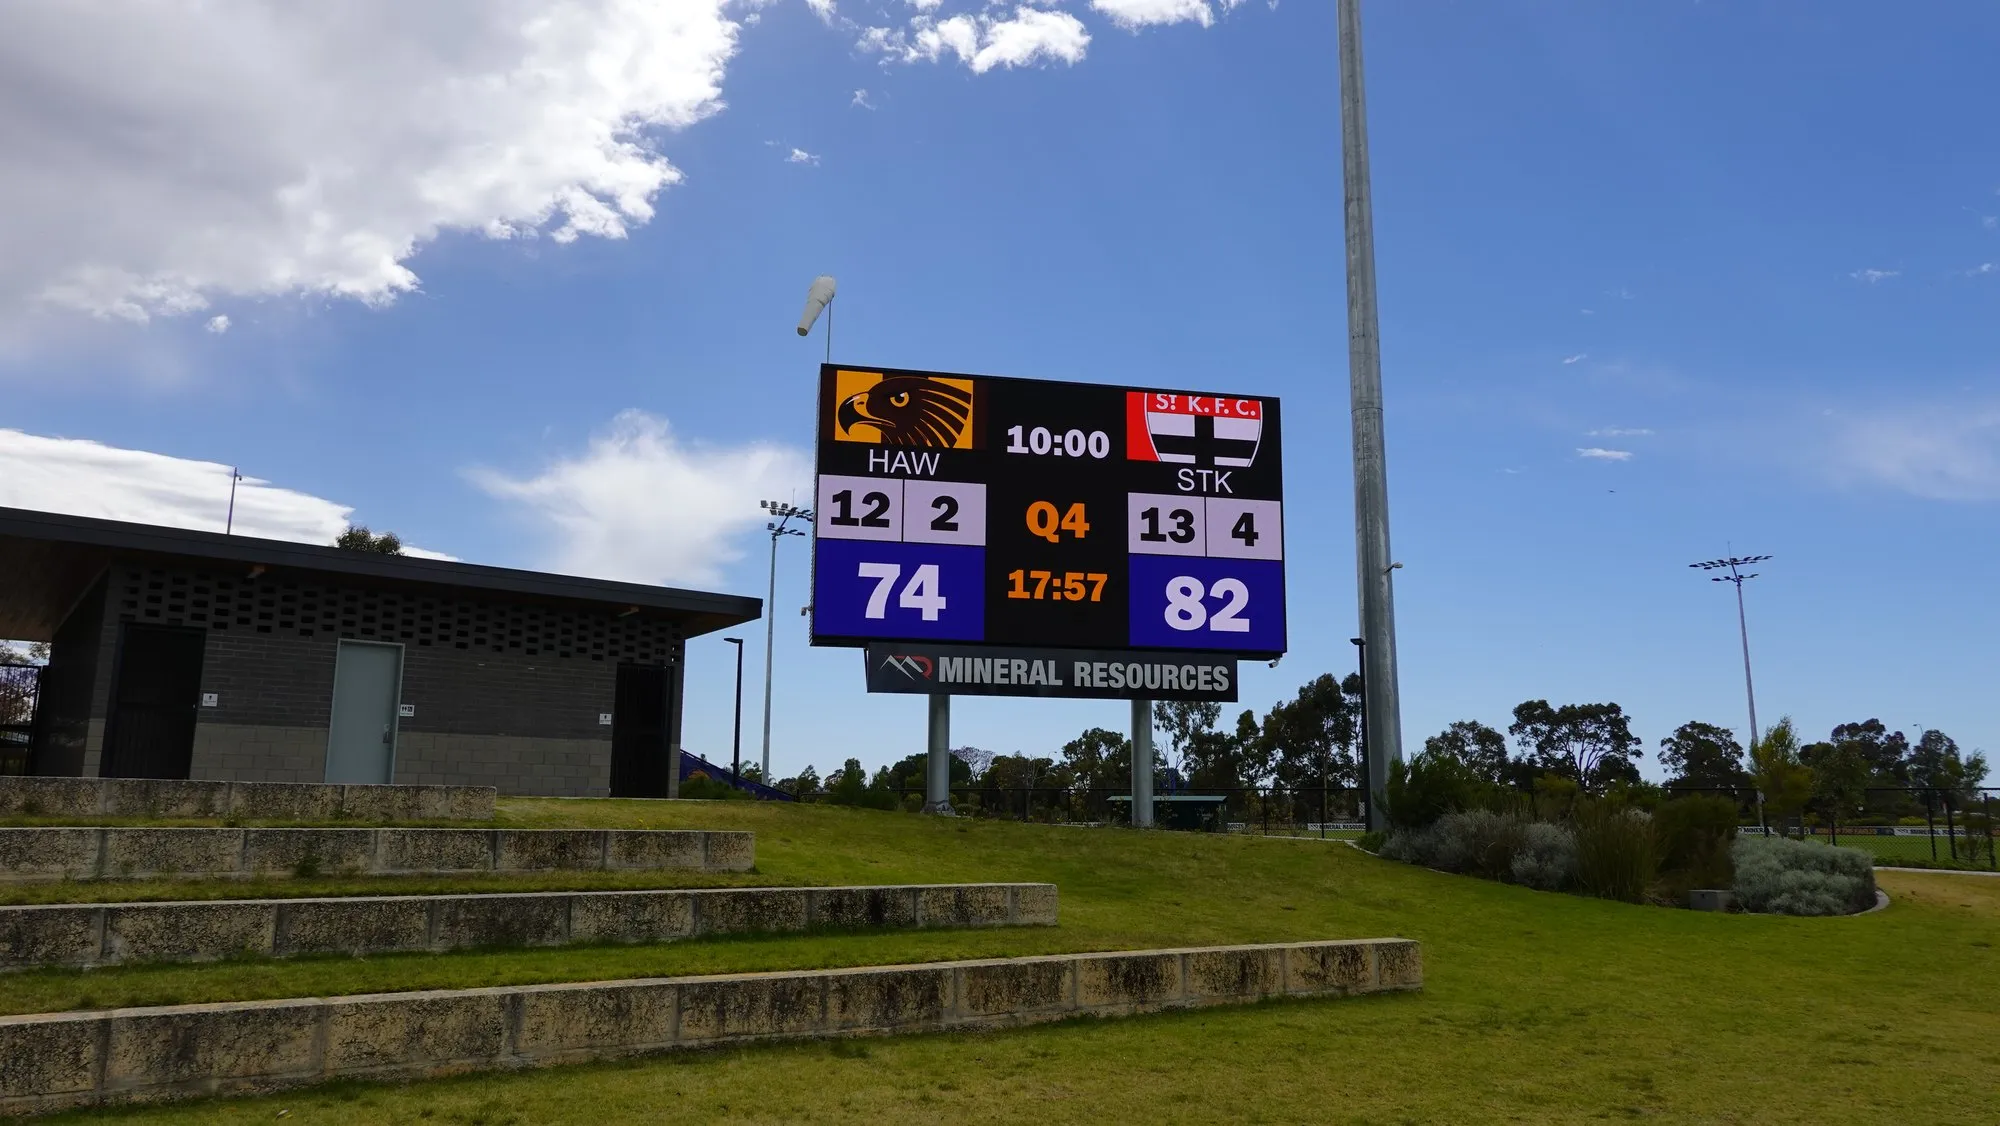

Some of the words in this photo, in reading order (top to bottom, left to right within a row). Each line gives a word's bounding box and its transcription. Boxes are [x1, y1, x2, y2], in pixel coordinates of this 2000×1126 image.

[1006, 425, 1110, 459] 10:00
[868, 449, 941, 476] HAW
[1177, 468, 1233, 494] STK
[830, 489, 891, 528] 12
[930, 495, 960, 532] 2
[1025, 500, 1090, 543] Q4
[1140, 506, 1196, 544] 13
[1231, 511, 1259, 547] 4
[857, 562, 947, 622] 74
[1007, 569, 1108, 602] 17:57
[1164, 575, 1250, 633] 82
[938, 656, 1063, 686] MINERAL
[1073, 661, 1230, 692] RESOURCES
